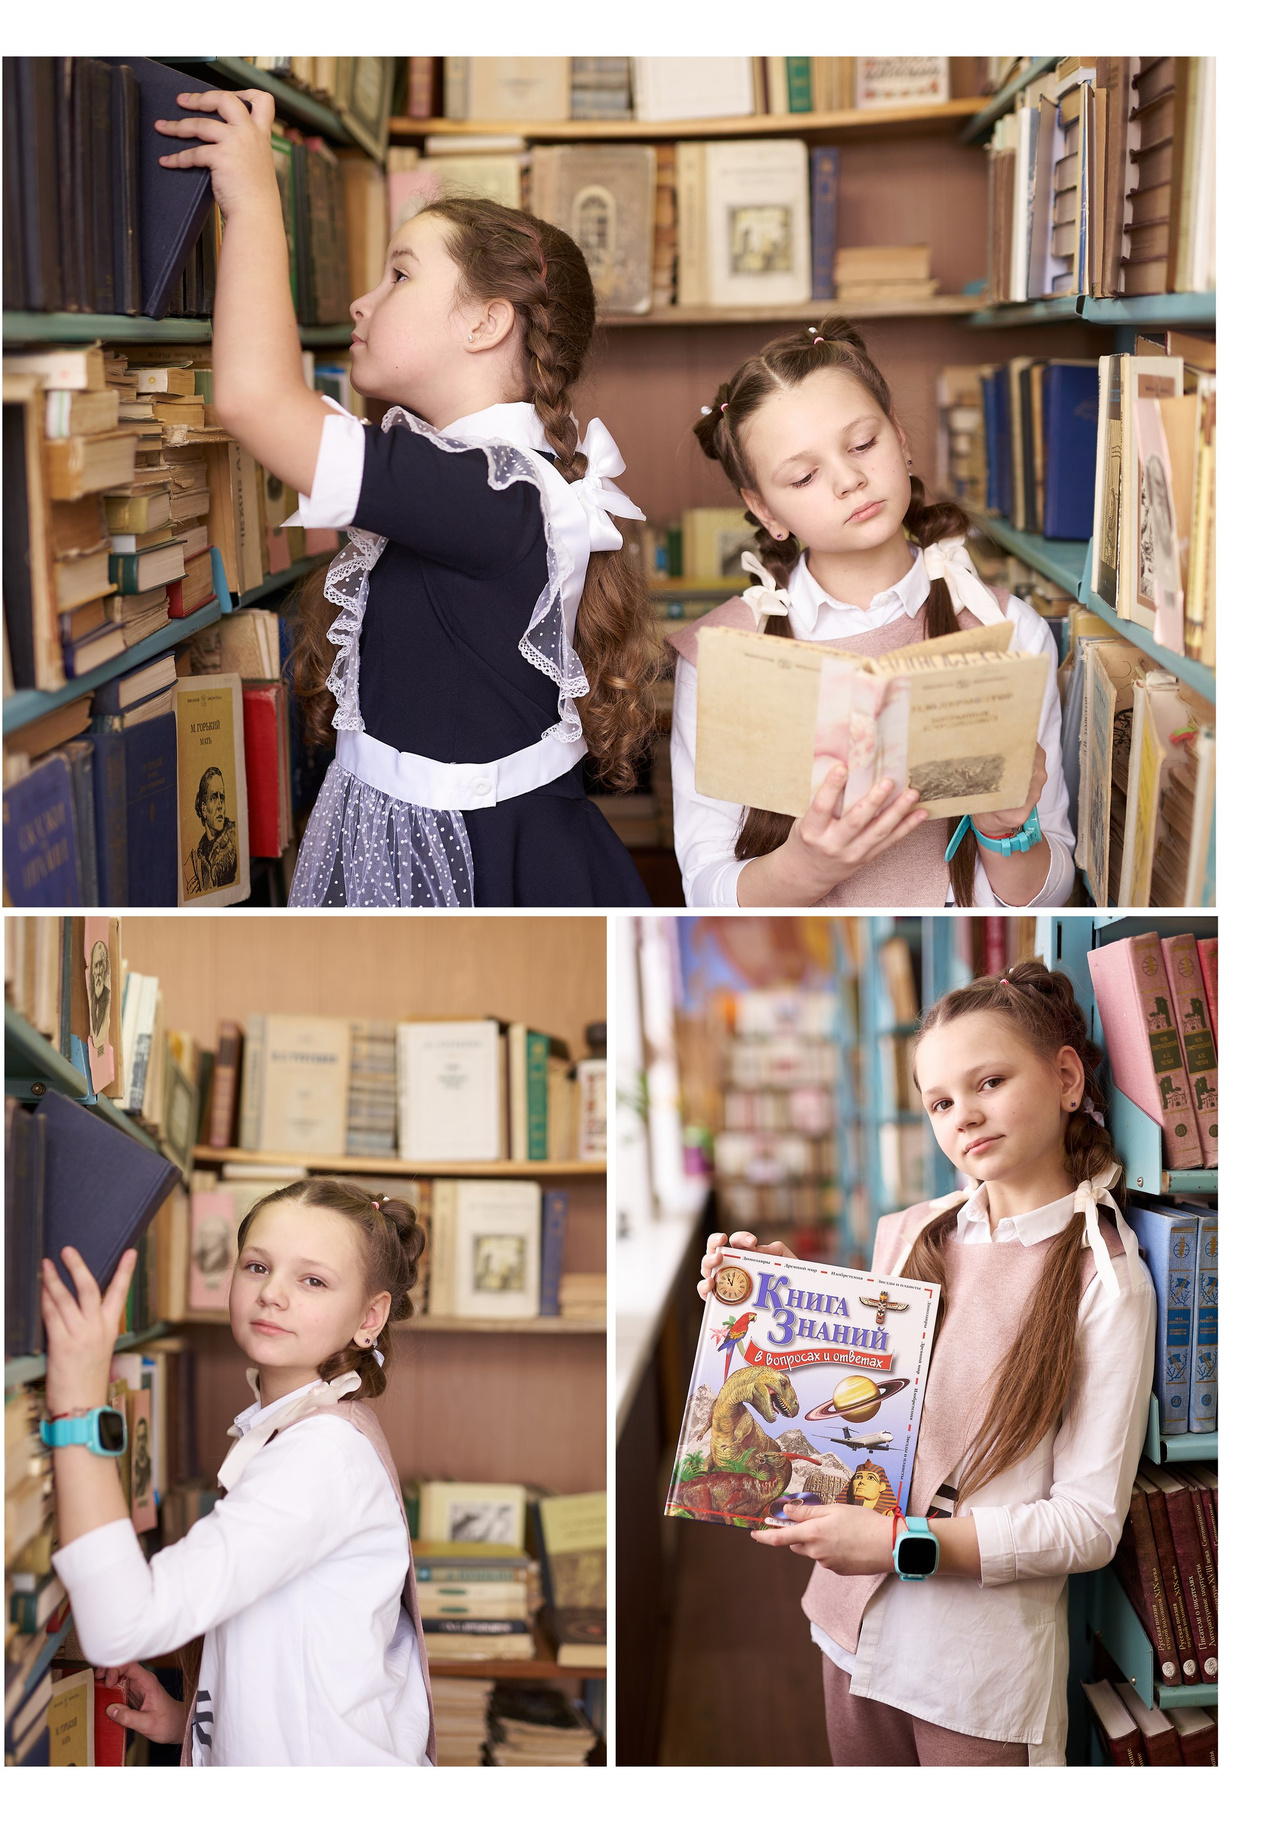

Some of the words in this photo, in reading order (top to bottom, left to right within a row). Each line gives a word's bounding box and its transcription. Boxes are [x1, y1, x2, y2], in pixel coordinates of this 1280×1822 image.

[741, 1255, 771, 1265] Динозавры
[783, 1263, 806, 1272] Древний
[831, 1271, 864, 1281] Изобретения
[923, 1300, 932, 1329] Динозавры
[765, 1350, 821, 1371] вопросах
[823, 1352, 831, 1360] и
[832, 1350, 884, 1369] ответах
[909, 1387, 919, 1421] Изобретения
[1151, 1567, 1159, 1582] века
[1195, 1563, 1207, 1597] портреты
[1188, 1575, 1200, 1610] писателях
[1151, 1604, 1160, 1626] поэзия
[1172, 1603, 1181, 1625] поэзия
[1202, 1597, 1217, 1646] Литературные
[1154, 1626, 1166, 1651] Русская
[1163, 1629, 1172, 1650] второй
[1176, 1625, 1186, 1651] Русская
[1195, 1616, 1208, 1650] Писатели
